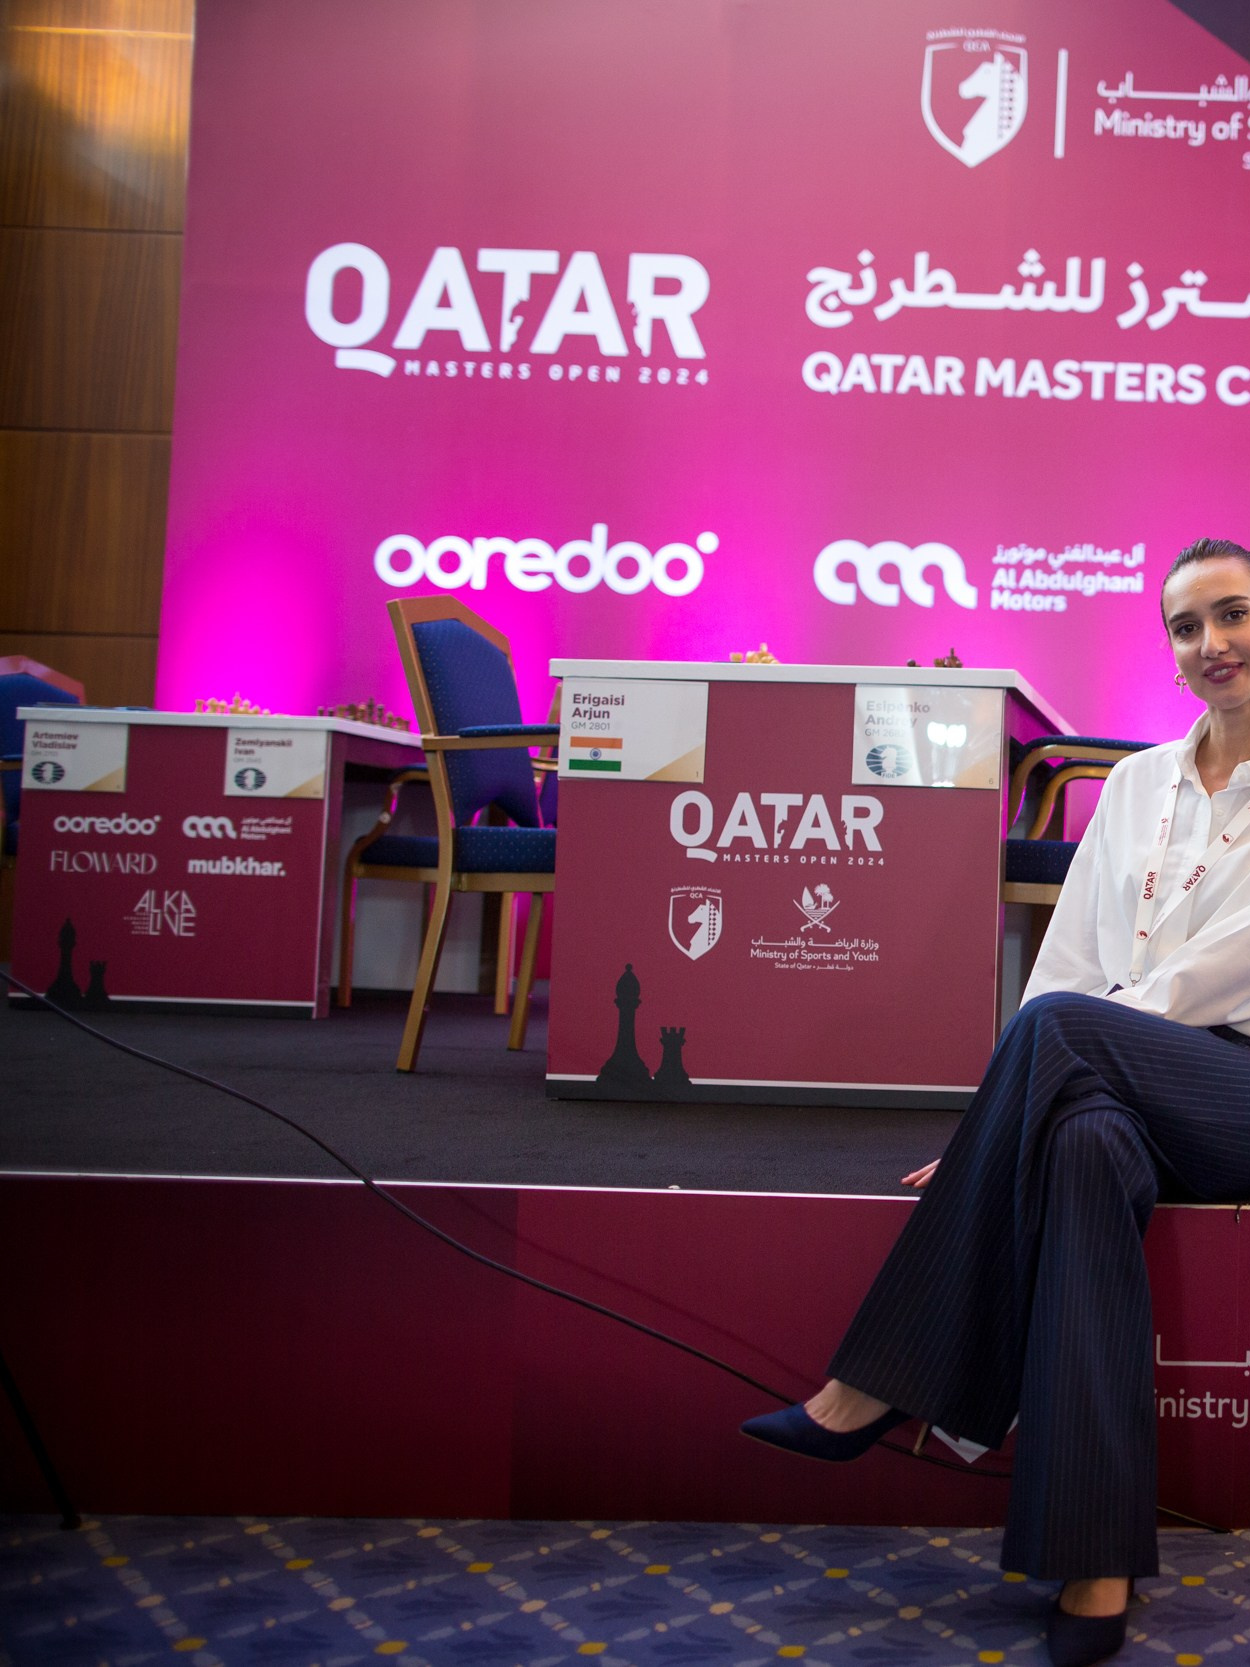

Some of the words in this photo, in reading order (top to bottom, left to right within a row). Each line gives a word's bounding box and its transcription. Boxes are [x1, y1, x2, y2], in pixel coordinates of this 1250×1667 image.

[1094, 108, 1206, 146] Ministry
[1212, 112, 1243, 140] of
[806, 249, 1105, 328] للشطرنج
[306, 243, 710, 380] QATAR
[405, 360, 530, 379] MASTERS
[549, 364, 620, 382] OPEN
[639, 367, 708, 385] 2024
[802, 352, 964, 395] QATAR
[975, 358, 1206, 404] MASTERS
[374, 523, 719, 596] ooredoo
[992, 568, 1017, 589] Al
[1017, 567, 1143, 598] Abdulghani
[991, 588, 1068, 611] Motors
[573, 694, 625, 707] Erigaisi
[866, 701, 930, 714] Esipenko
[572, 707, 610, 720] Arjun
[571, 721, 586, 730] GM
[589, 722, 610, 731] 2801
[865, 729, 880, 737] GM
[53, 812, 162, 836] ooredoo
[670, 791, 883, 865] QATAR
[50, 851, 157, 874] FLOWARD
[187, 856, 286, 877] mubkhar.
[724, 854, 789, 863] MASTERS
[800, 856, 837, 864] OPEN
[848, 857, 884, 865] 2024
[1143, 871, 1156, 900] QATAR
[1182, 864, 1206, 892] QATAR
[133, 890, 196, 914] ALKA
[752, 936, 806, 948] والشباب
[808, 938, 858, 949] الرياضة
[861, 939, 879, 950] وزارة
[751, 949, 787, 961] Ministry
[789, 949, 799, 959] of
[801, 950, 831, 961] Sports
[833, 951, 849, 960] and
[852, 952, 878, 961] Youth
[1155, 1389, 1248, 1428] nistry
